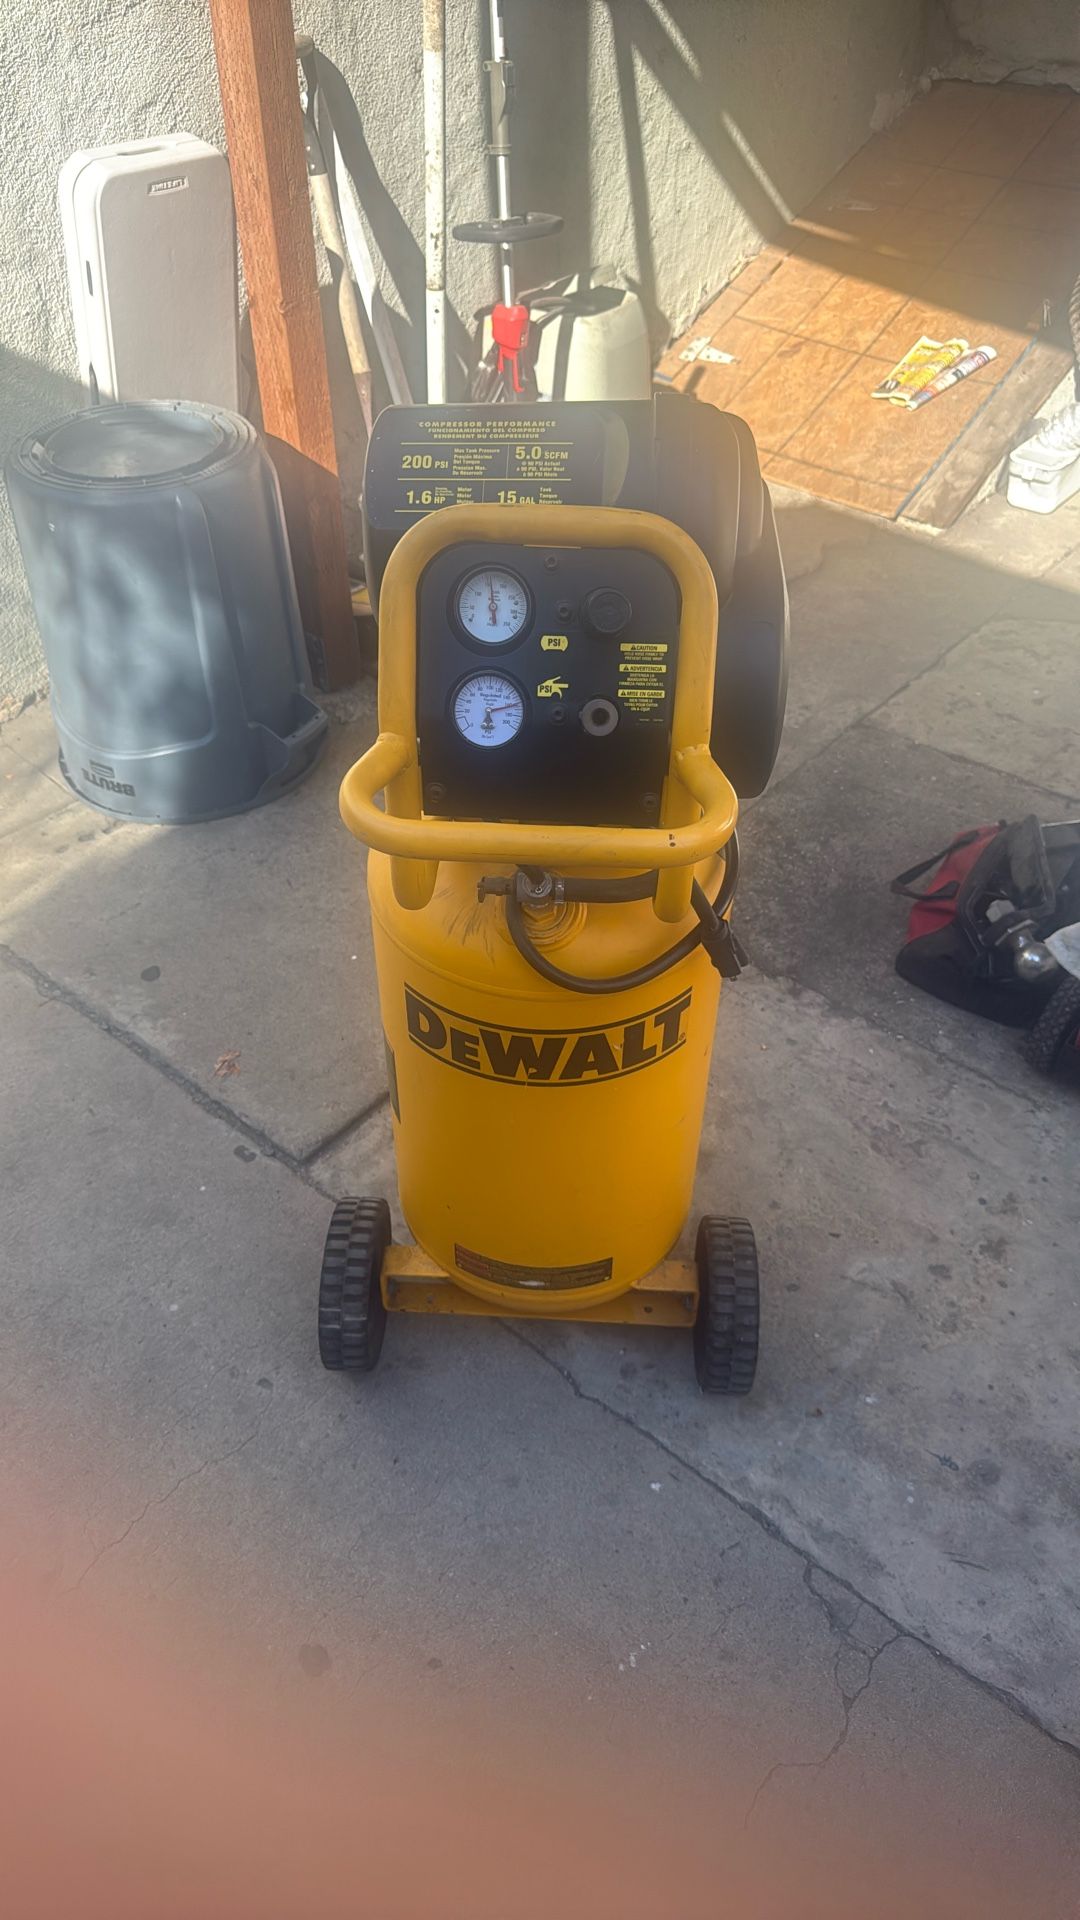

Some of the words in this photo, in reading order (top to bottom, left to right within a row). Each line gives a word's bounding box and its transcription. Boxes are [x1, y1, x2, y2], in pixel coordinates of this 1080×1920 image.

[515, 446, 541, 459] 5.0
[402, 455, 433, 469] 200
[434, 461, 448, 469] PSI
[406, 490, 432, 504] 1.6
[498, 490, 516, 504] 15
[547, 638, 561, 646] PSI
[539, 685, 552, 693] PSI
